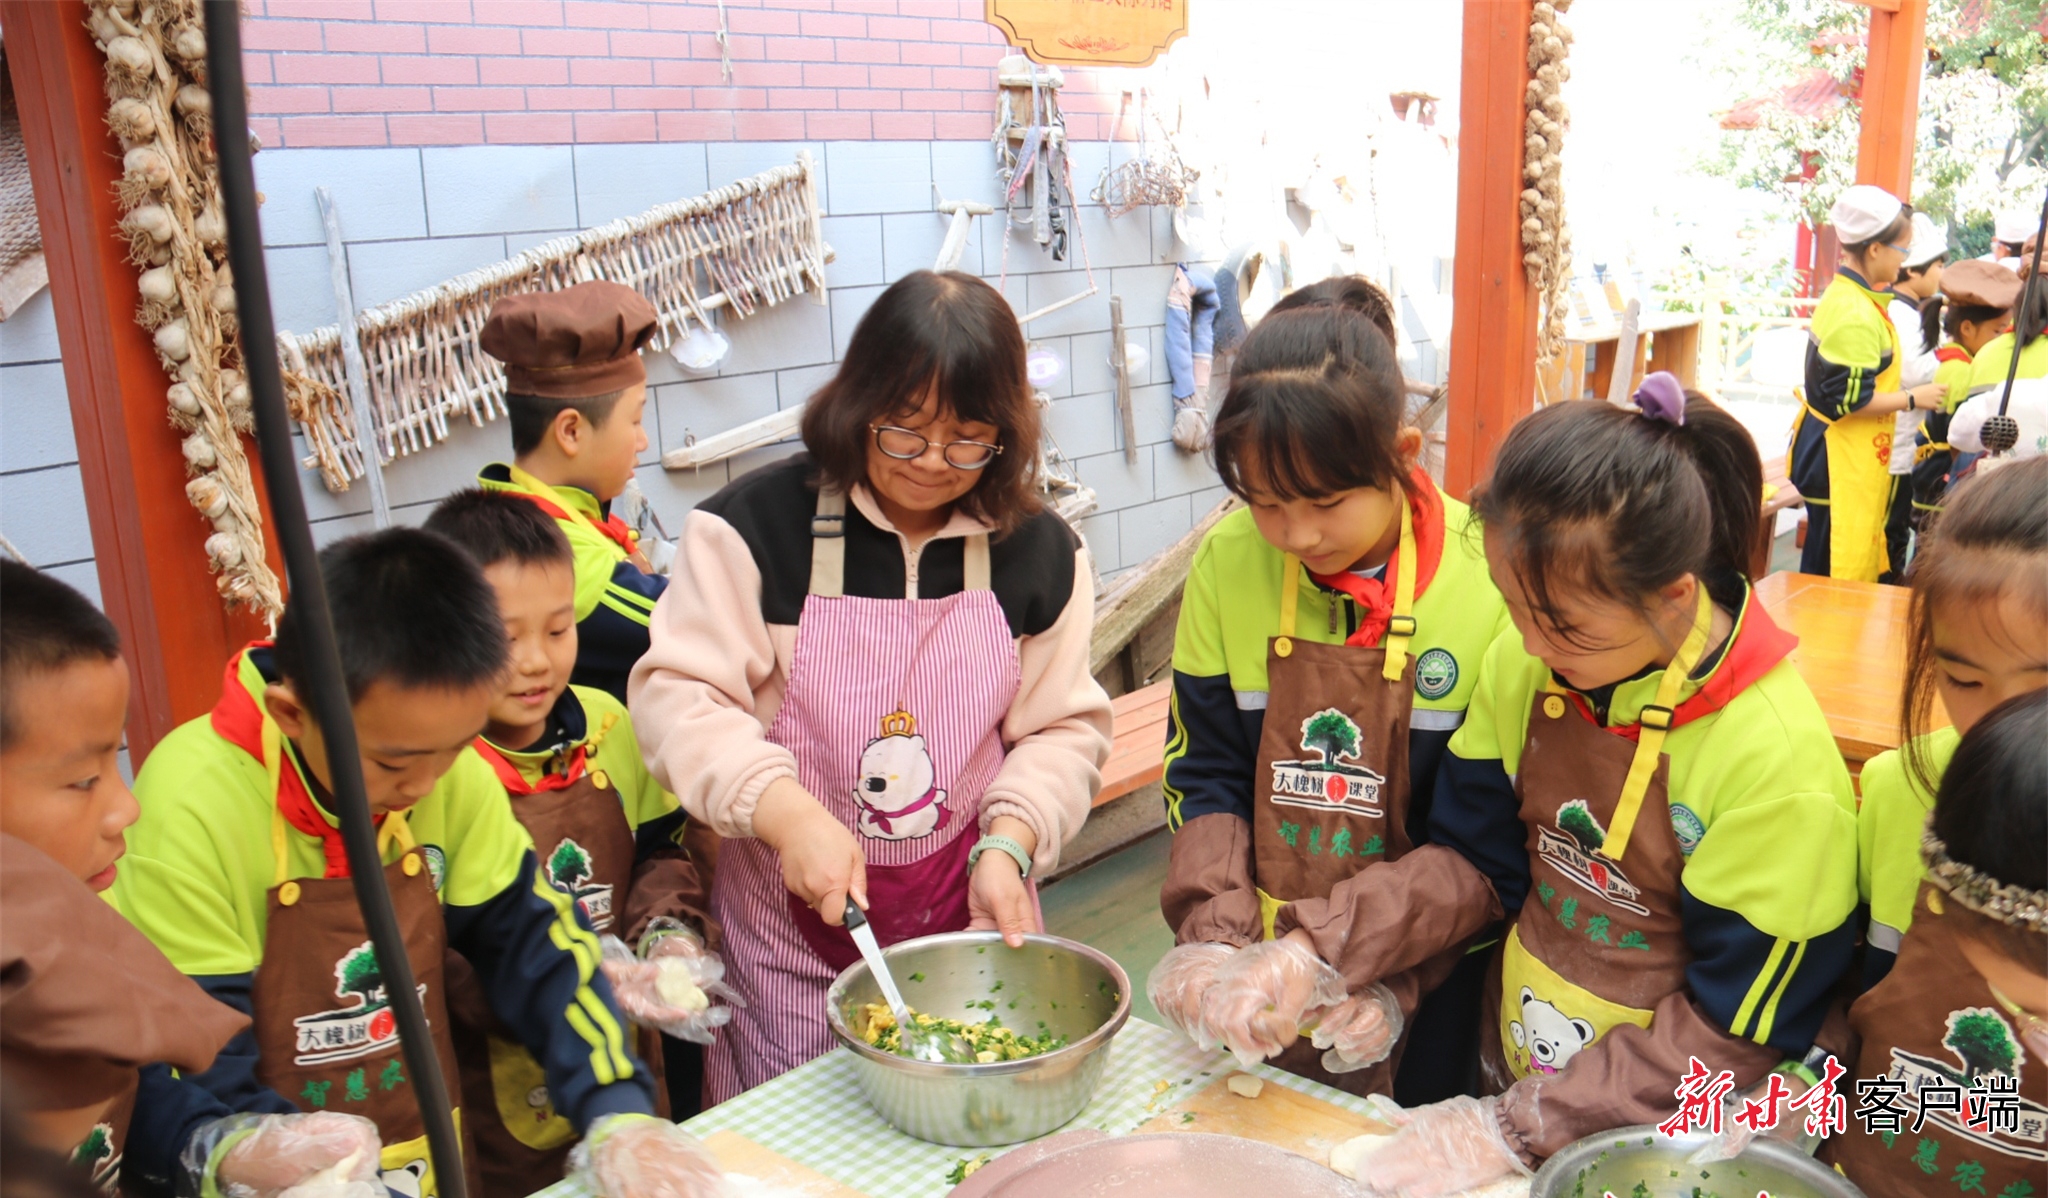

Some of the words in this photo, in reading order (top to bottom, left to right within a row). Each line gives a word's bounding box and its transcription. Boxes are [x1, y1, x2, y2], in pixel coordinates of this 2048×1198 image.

[1276, 772, 1323, 794] 大槐树
[1349, 781, 1377, 801] 课堂
[1277, 820, 1385, 858] 智慧农业
[1538, 879, 1650, 951] 智慧农业
